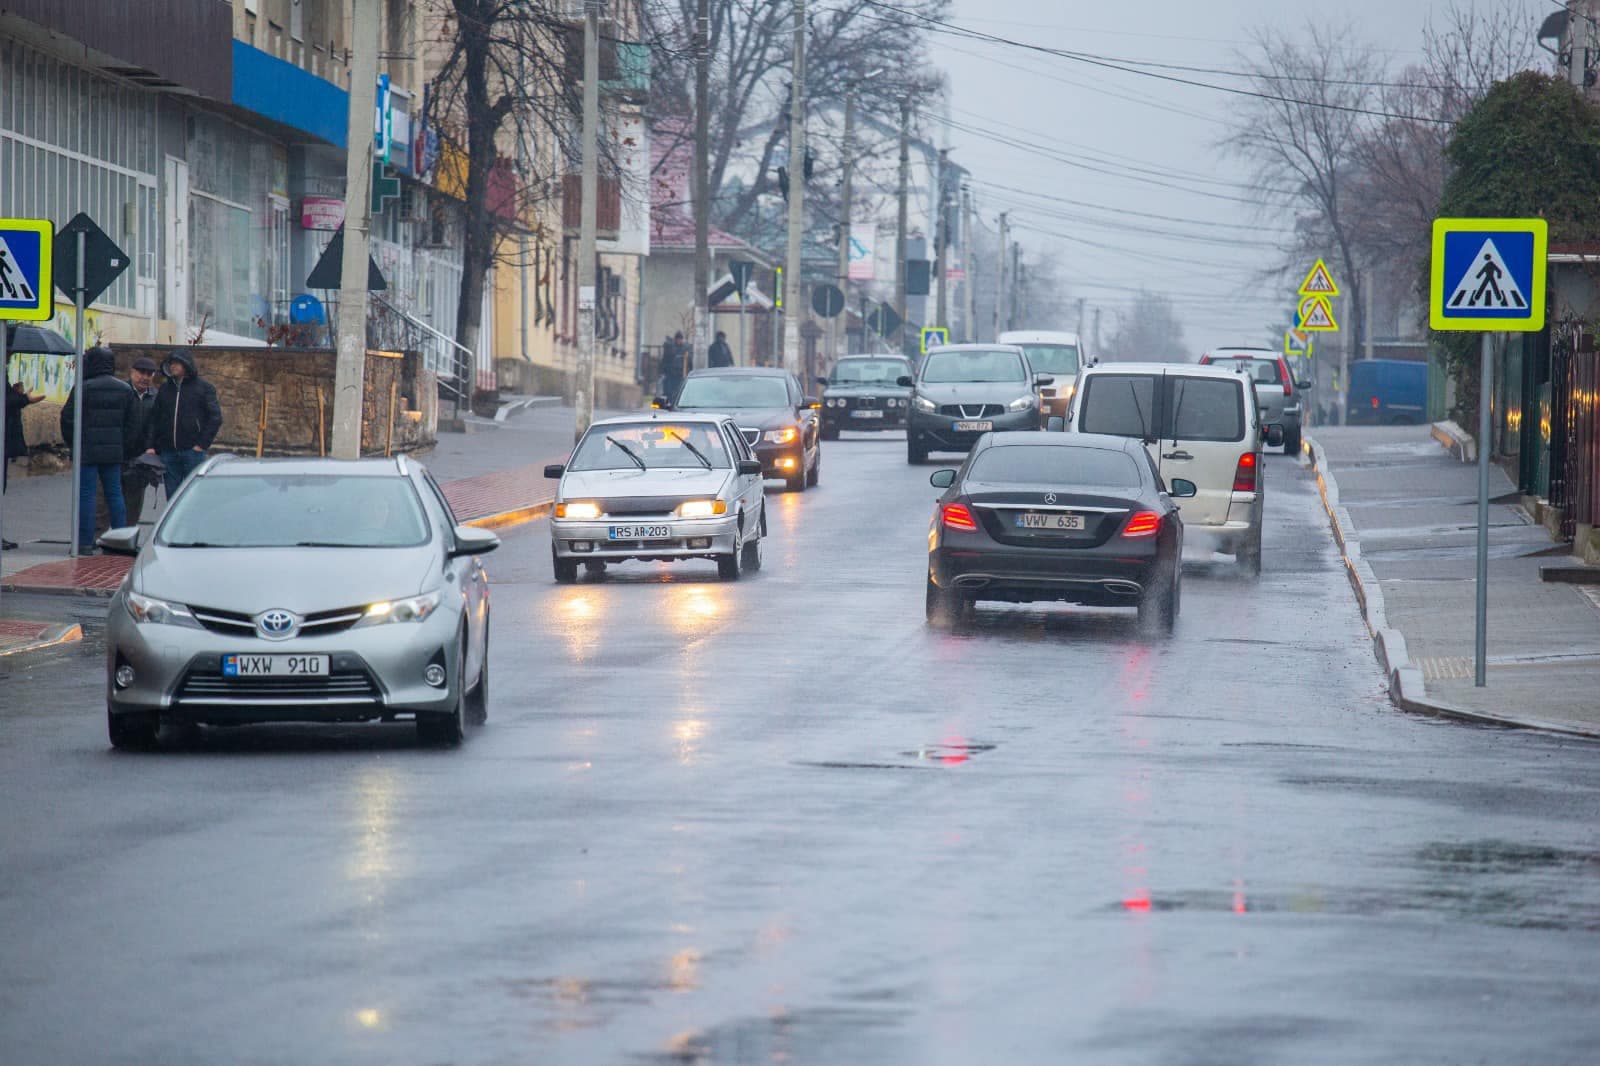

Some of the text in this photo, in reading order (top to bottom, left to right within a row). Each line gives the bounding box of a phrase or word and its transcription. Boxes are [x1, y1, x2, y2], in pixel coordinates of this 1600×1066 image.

[1026, 515, 1079, 528] VWV 635
[616, 527, 632, 537] RS
[648, 526, 668, 537] 203
[239, 657, 320, 673] WXW 910
